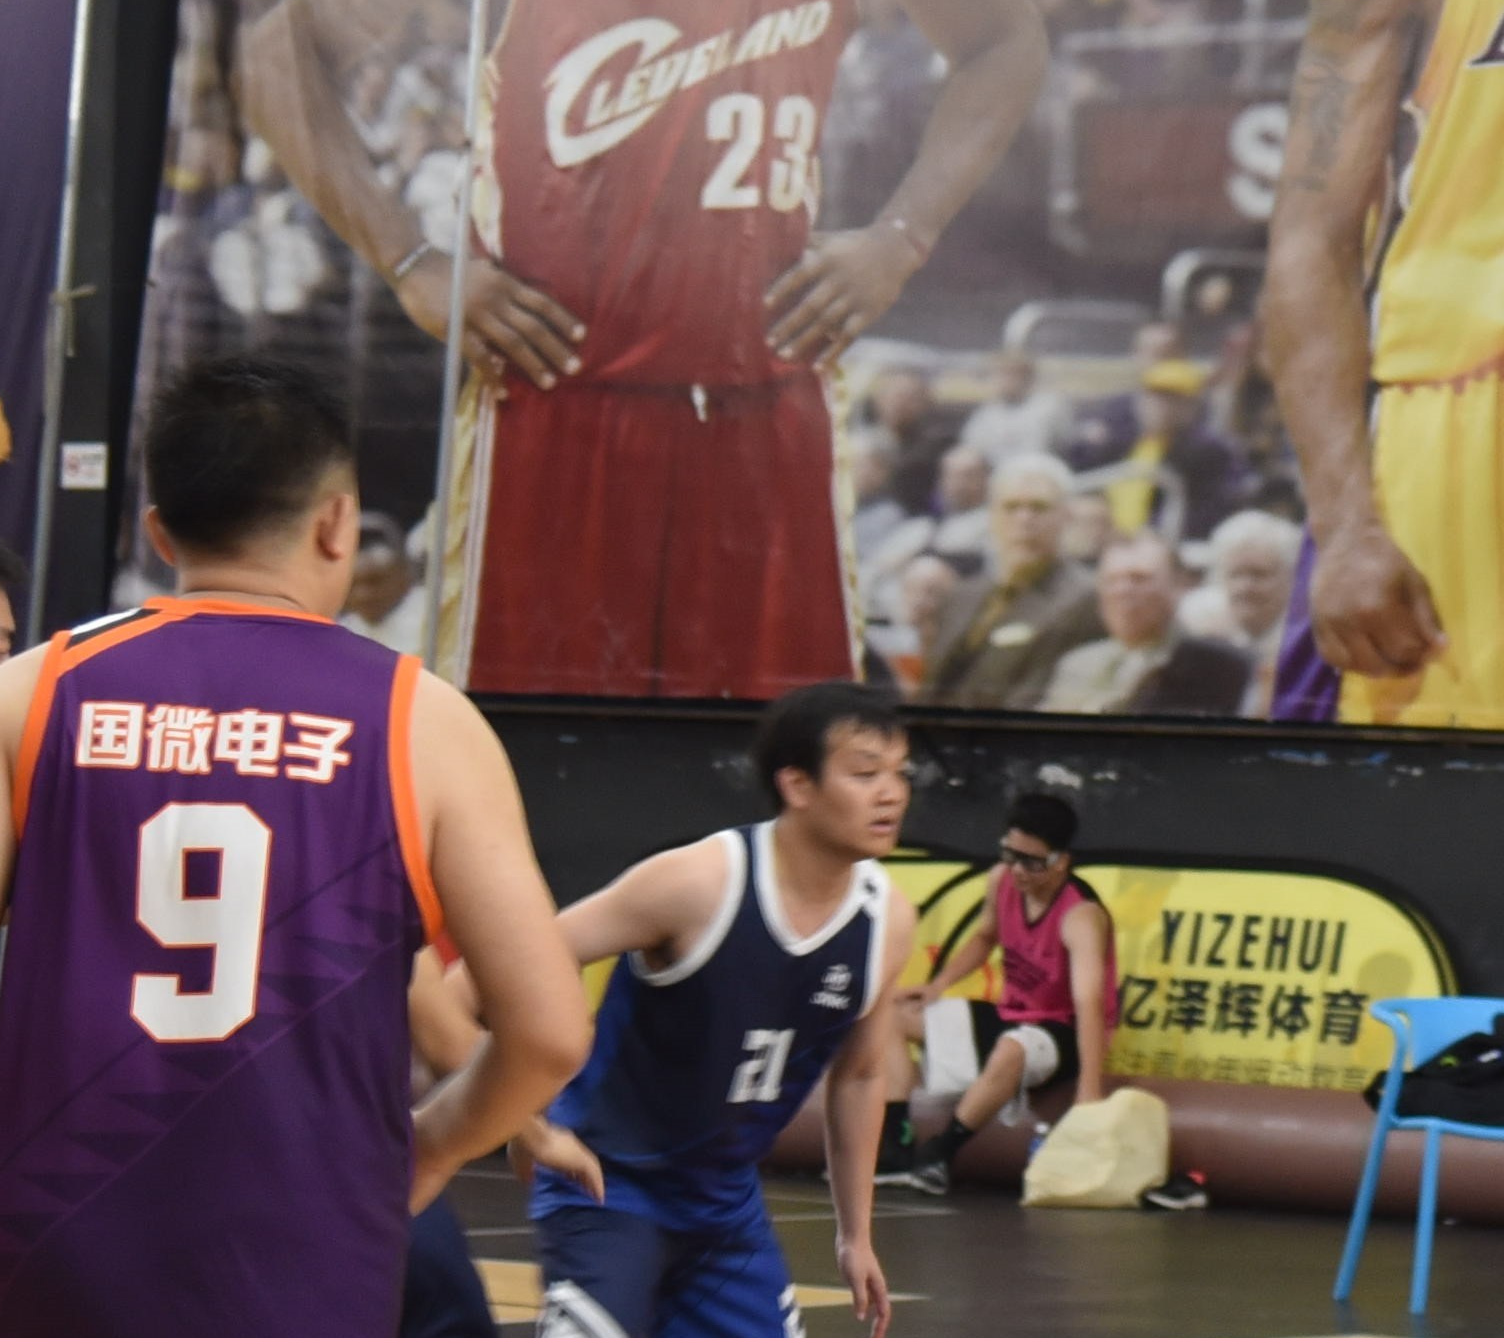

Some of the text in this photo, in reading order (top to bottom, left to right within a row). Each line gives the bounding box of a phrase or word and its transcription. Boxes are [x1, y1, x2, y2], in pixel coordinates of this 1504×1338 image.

[543, 0, 833, 168] CLEVELAND
[701, 92, 820, 213] 23
[75, 700, 355, 784] 国微电子
[130, 801, 272, 1044] 9
[1161, 910, 1348, 975] YIZEHUI
[1116, 974, 1370, 1046] 亿泽辉体育
[726, 1028, 798, 1104] 21
